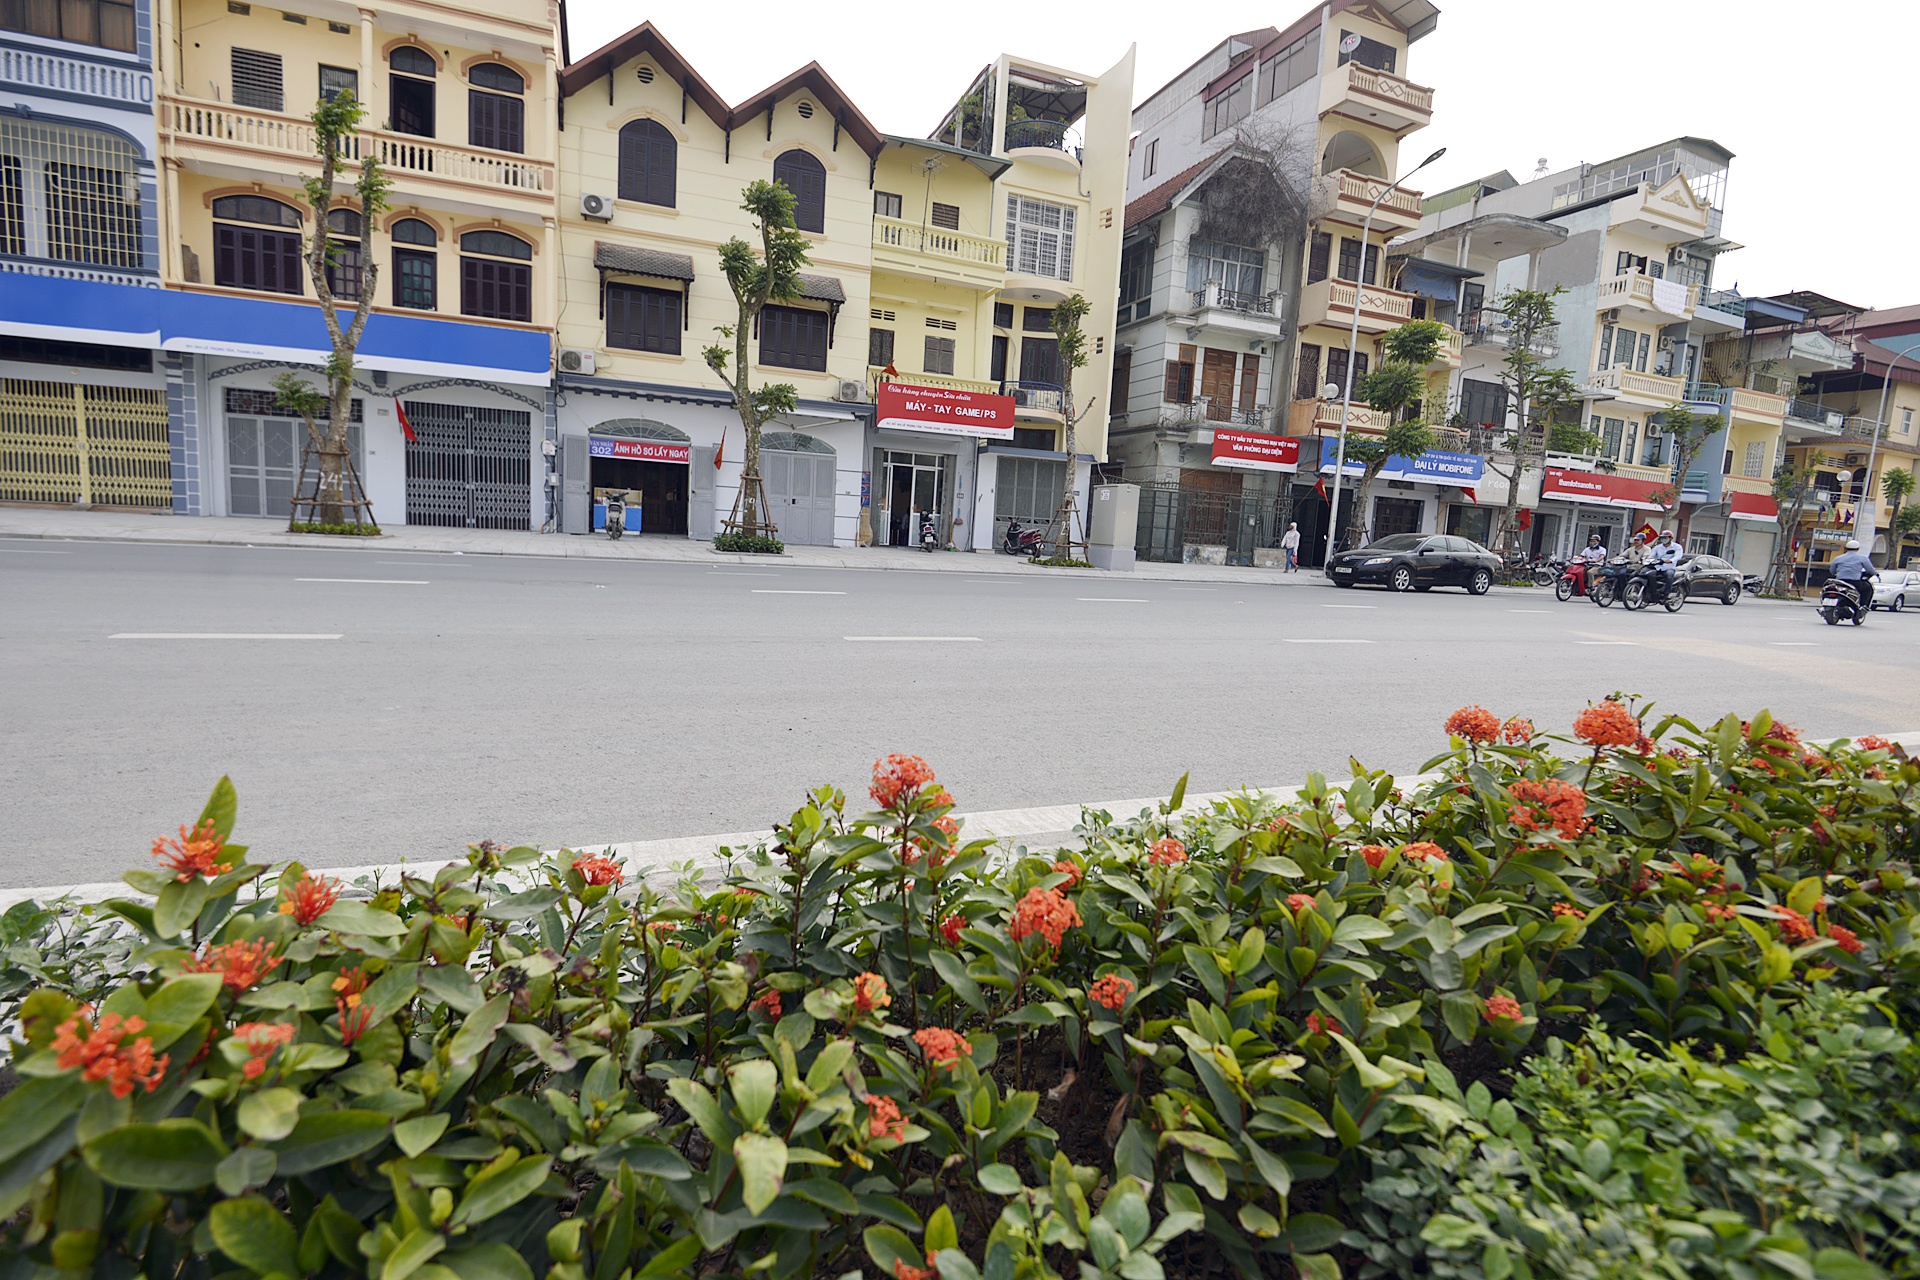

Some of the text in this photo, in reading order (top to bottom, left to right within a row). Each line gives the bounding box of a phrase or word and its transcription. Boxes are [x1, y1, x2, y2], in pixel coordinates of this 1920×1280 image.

[902, 387, 919, 396] hàng
[906, 400, 926, 411] MÁY
[934, 405, 951, 414] TAY
[955, 406, 996, 418] GAME/PS
[592, 446, 611, 454] 302
[614, 443, 688, 458] ẢNH HỒ SƠ LẤY NGAY
[1244, 445, 1261, 453] PHÒNG
[1414, 459, 1473, 475] ĐẠI LÝ MOBIFONE
